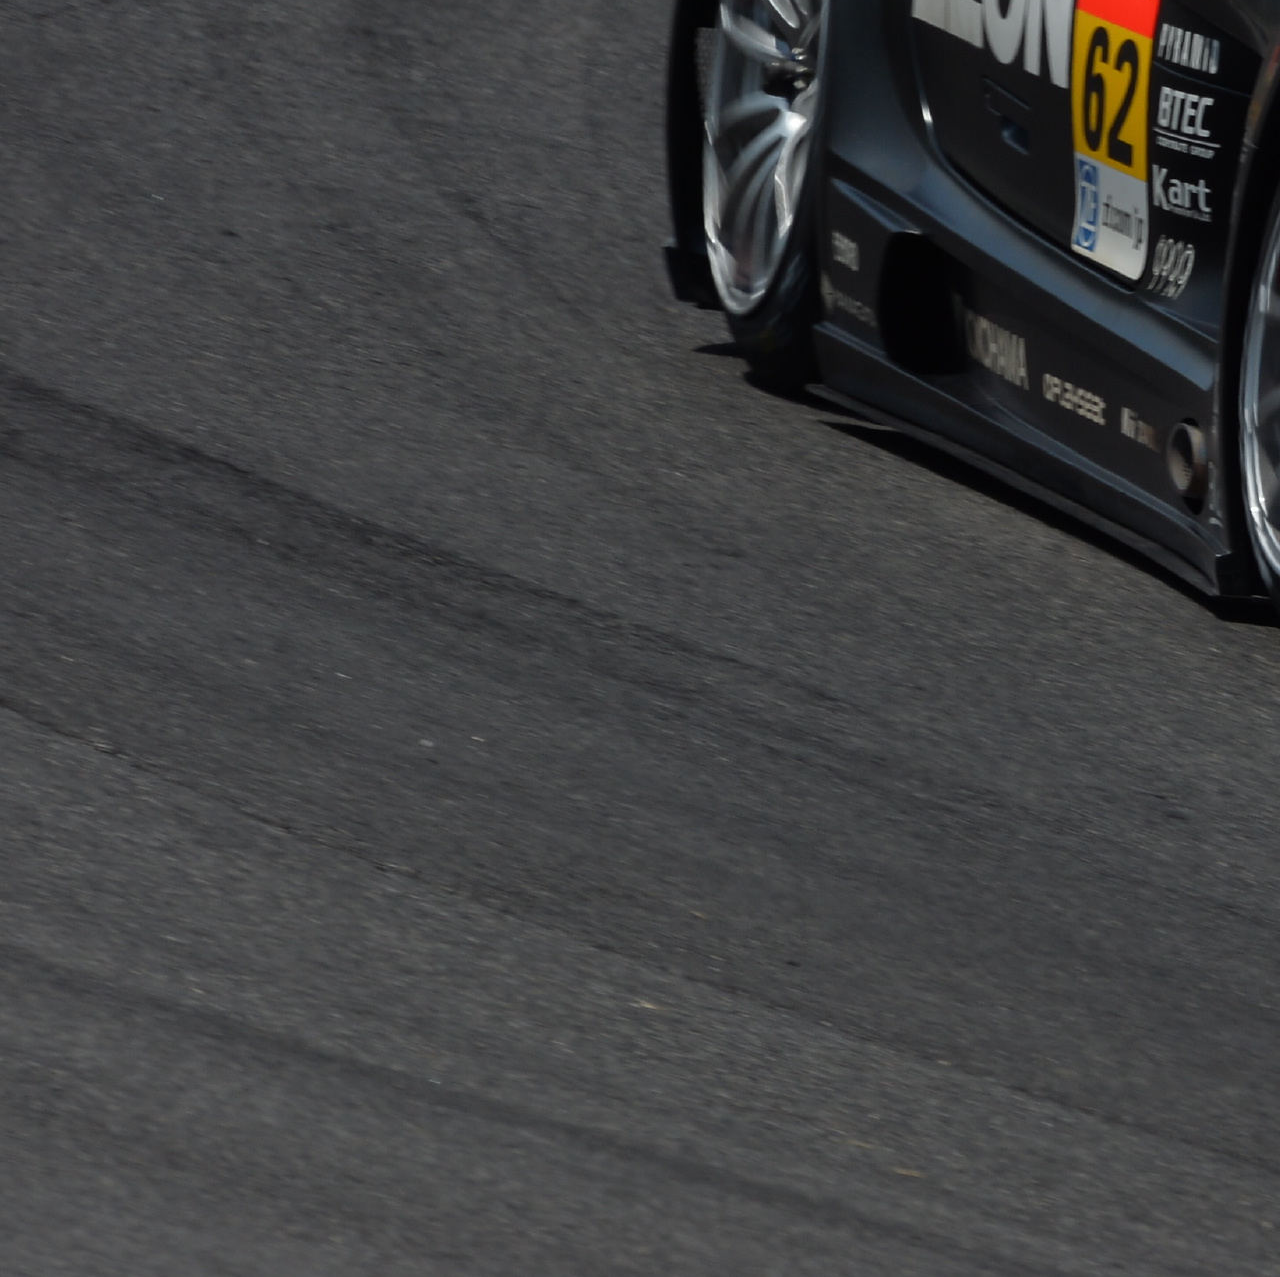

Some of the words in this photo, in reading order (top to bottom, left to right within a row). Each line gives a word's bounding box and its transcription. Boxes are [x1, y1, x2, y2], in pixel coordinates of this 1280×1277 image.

[1082, 25, 1139, 168] 62
[1157, 85, 1215, 138] BTEC
[1152, 164, 1213, 213] Kart
